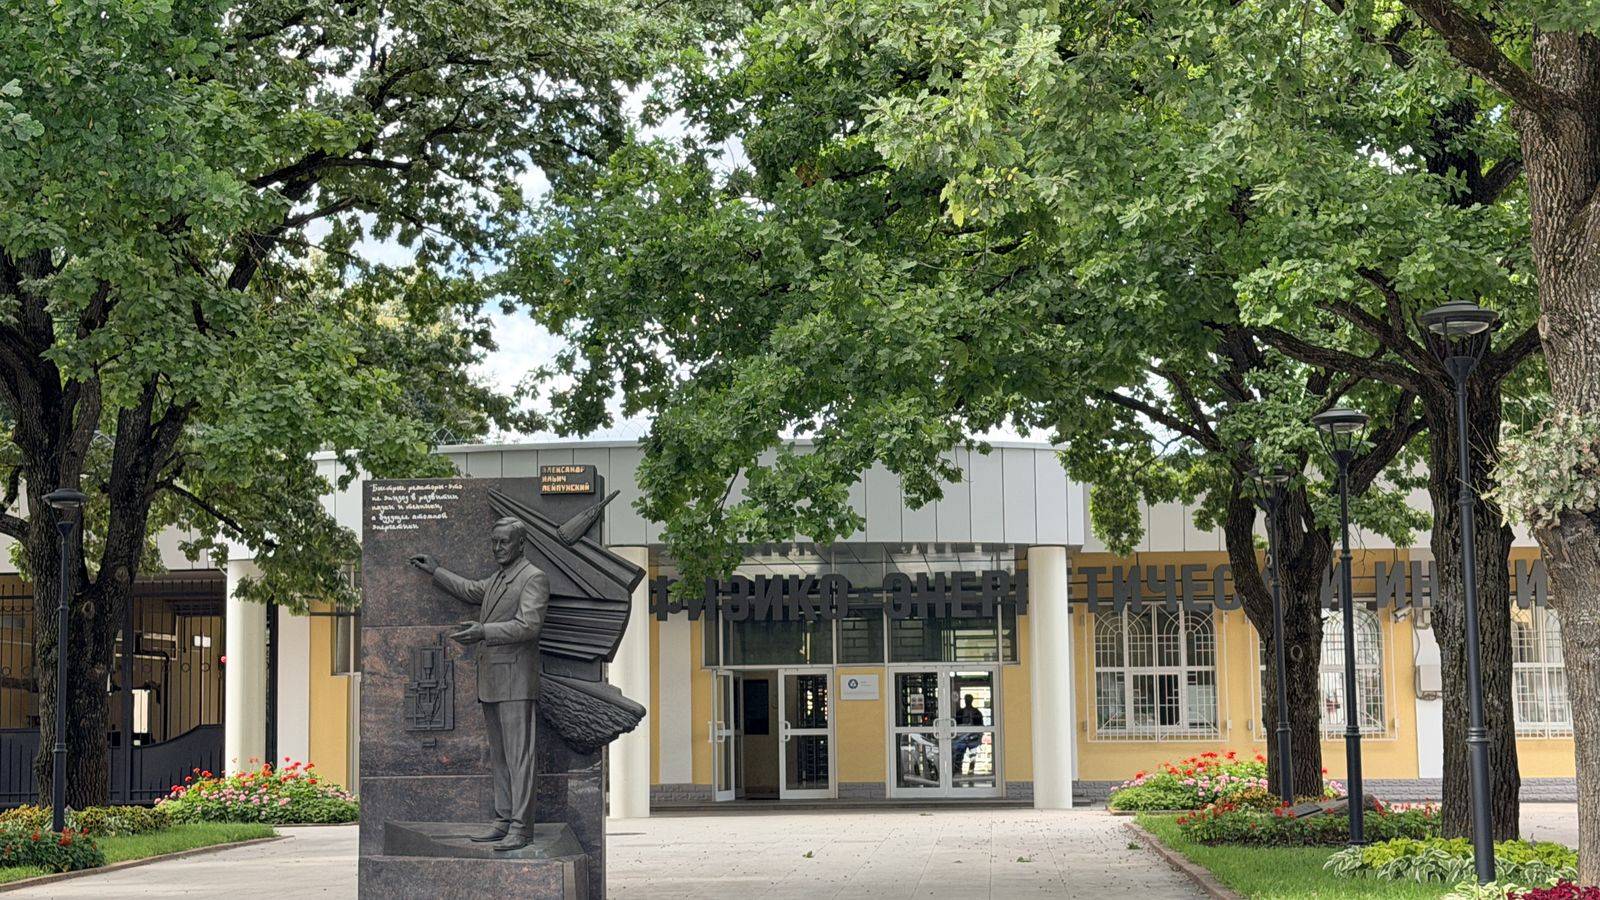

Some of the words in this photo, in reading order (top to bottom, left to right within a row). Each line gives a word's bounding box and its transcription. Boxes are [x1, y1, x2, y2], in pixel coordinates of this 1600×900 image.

[542, 482, 590, 491] ЛЕЙПУНСКИЙ
[384, 495, 409, 503] эпизод
[411, 492, 416, 500] в
[418, 492, 459, 503] развитии
[372, 504, 395, 514] науки
[379, 513, 410, 524] будущее
[412, 512, 448, 520] атомной
